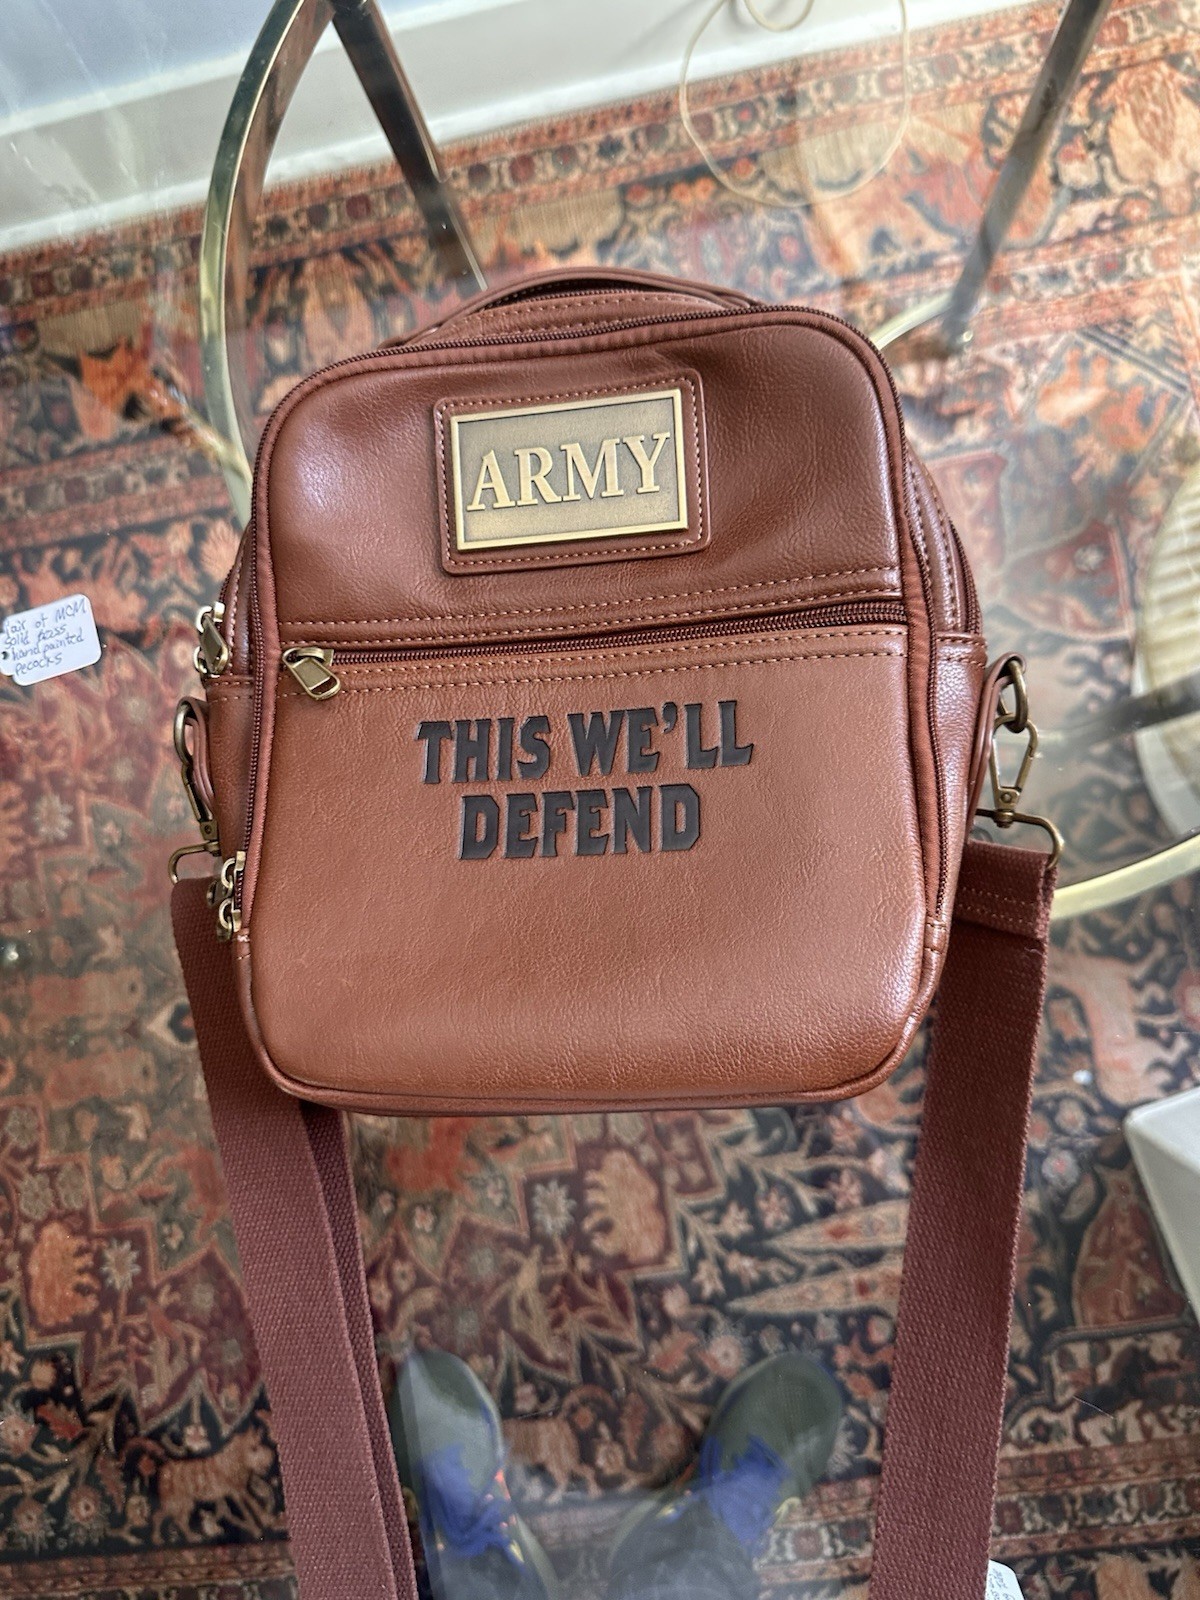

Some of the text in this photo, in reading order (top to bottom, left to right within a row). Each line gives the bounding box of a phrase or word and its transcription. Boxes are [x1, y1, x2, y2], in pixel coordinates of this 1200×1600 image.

[466, 431, 670, 511] ARMY
[12, 627, 84, 661] hand painted
[35, 613, 48, 629] of
[55, 598, 86, 622] MCM
[416, 700, 754, 784] THIS WE'LL
[458, 783, 701, 860] DEFEND
